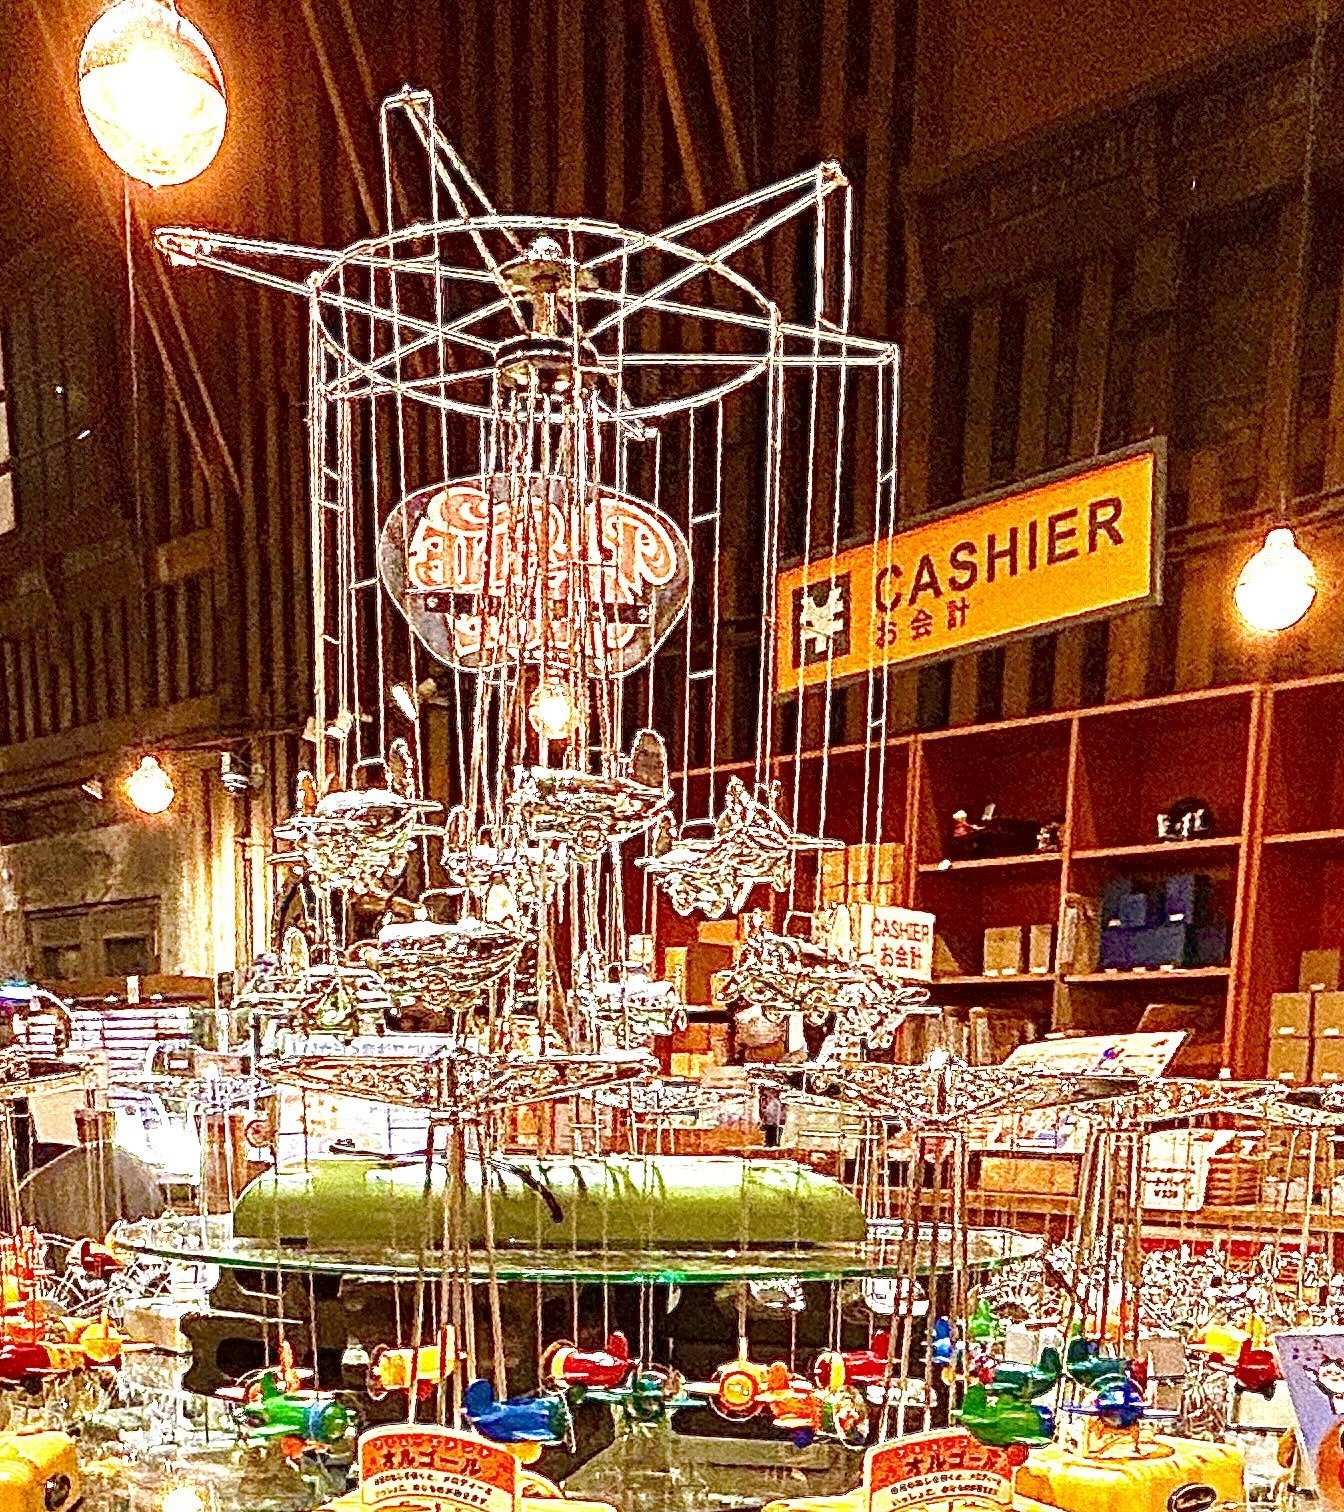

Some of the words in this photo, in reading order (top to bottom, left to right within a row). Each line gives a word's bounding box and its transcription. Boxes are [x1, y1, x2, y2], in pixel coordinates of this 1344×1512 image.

[874, 496, 1125, 613] CASHIER
[875, 598, 970, 650] お会計
[872, 917, 929, 943] CASHIER
[880, 943, 923, 970] お会計
[382, 1448, 481, 1476] オルゴール
[904, 1449, 998, 1476] オルゴール
